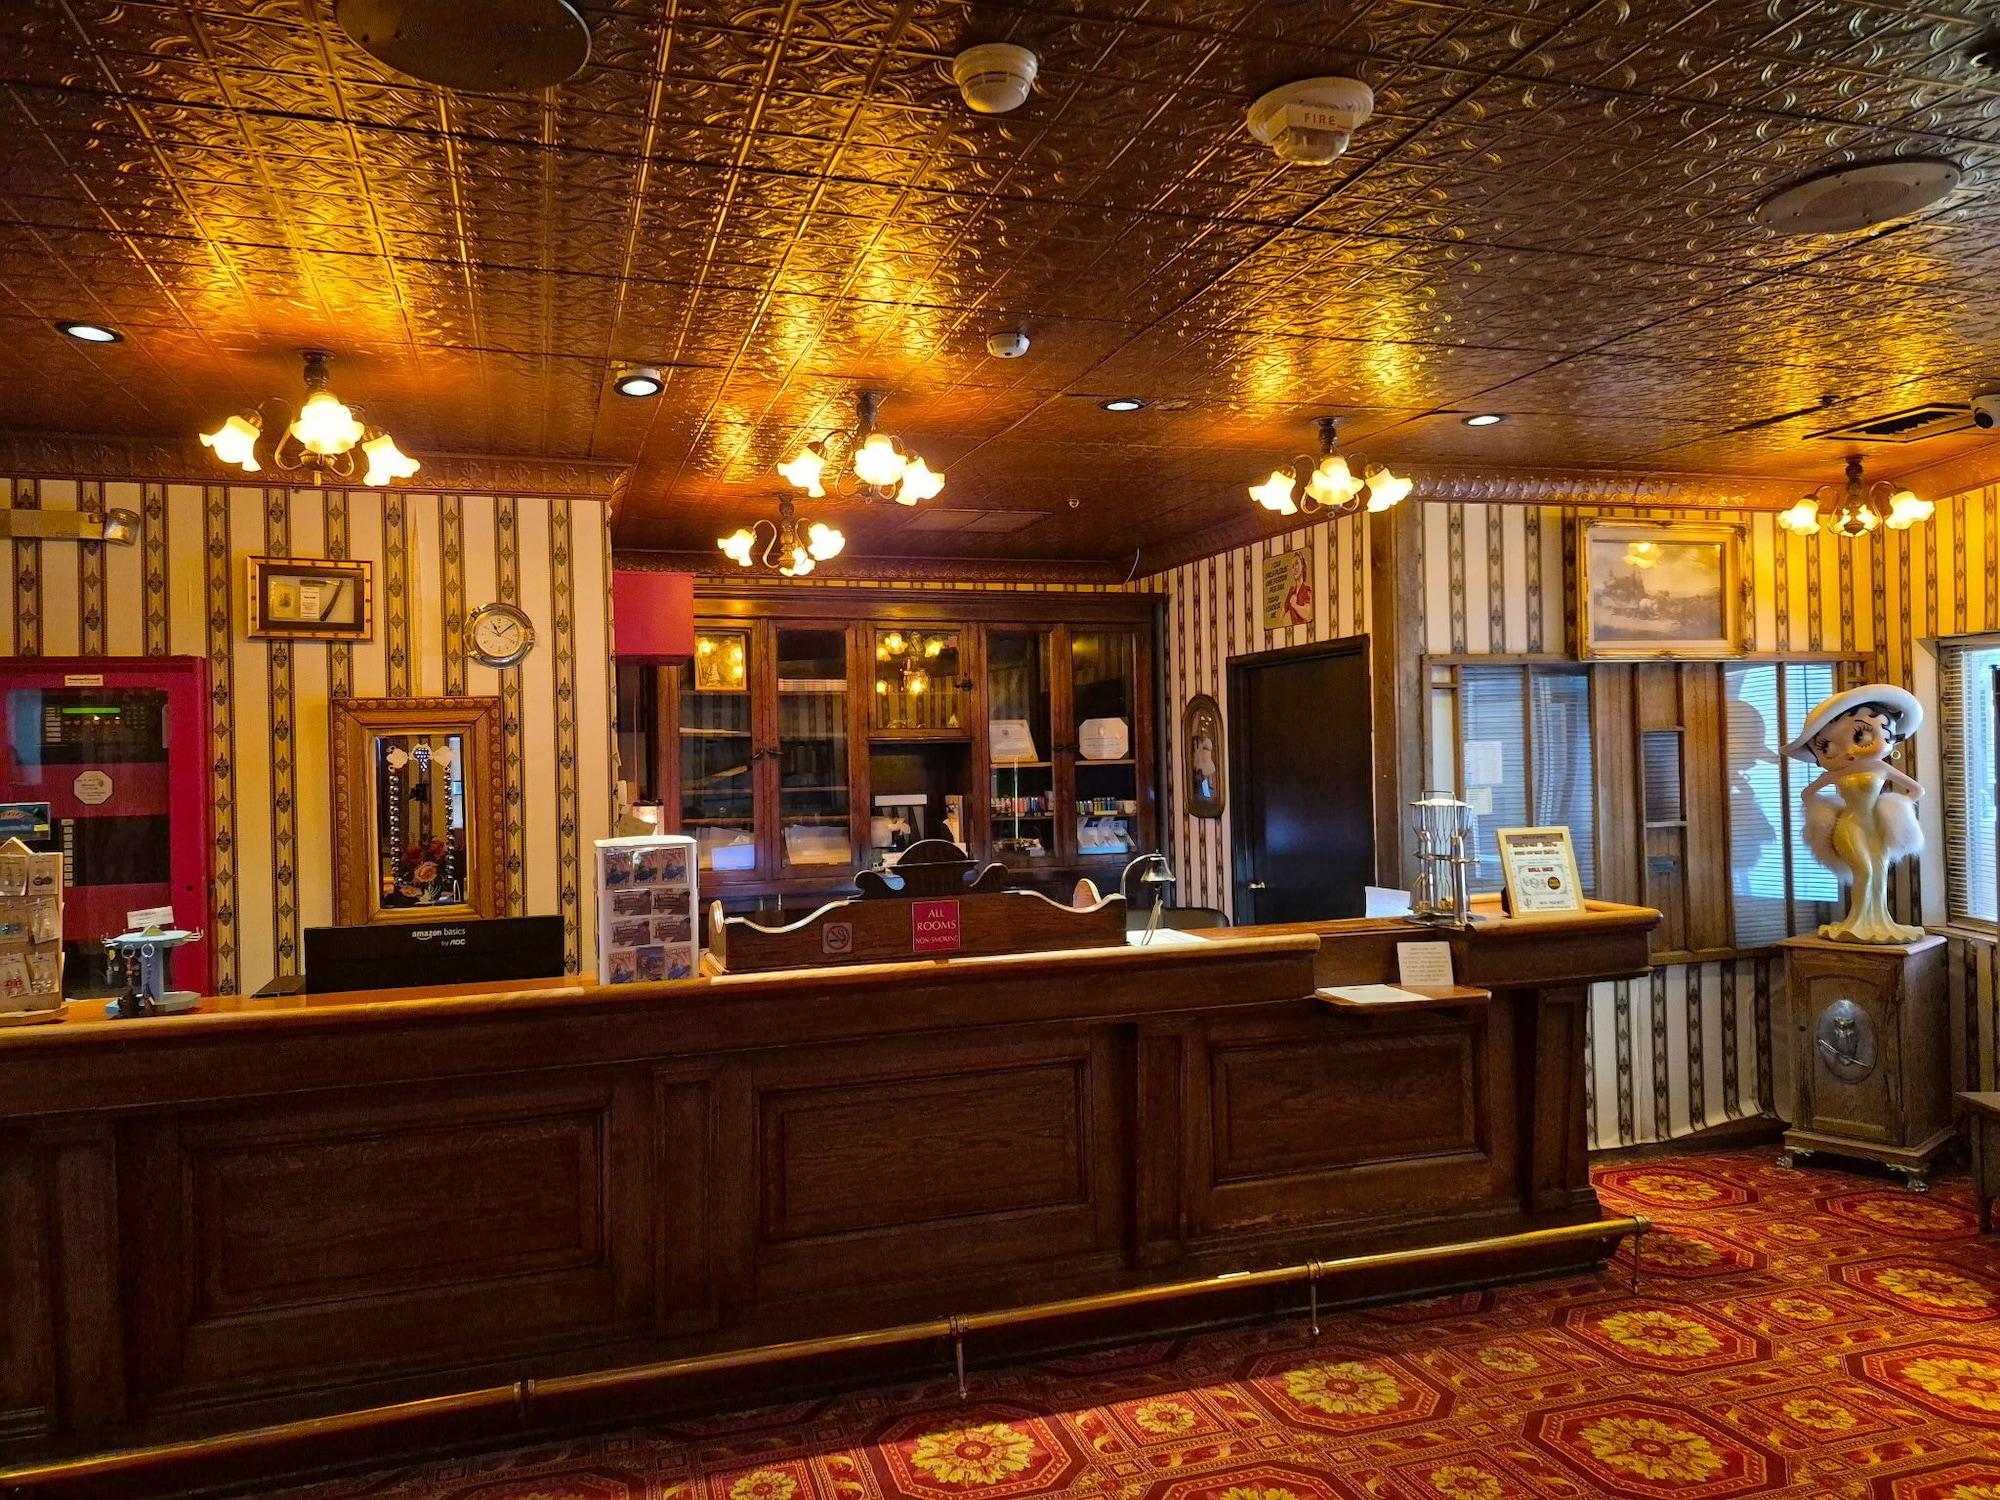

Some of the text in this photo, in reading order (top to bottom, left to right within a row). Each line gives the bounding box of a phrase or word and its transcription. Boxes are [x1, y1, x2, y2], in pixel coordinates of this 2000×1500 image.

[1304, 112, 1336, 126] FIRE
[928, 909, 944, 918] ALL
[917, 920, 957, 931] ROOMS
[412, 928, 466, 940] amazon basics
[915, 935, 959, 944] NON-SMOKING
